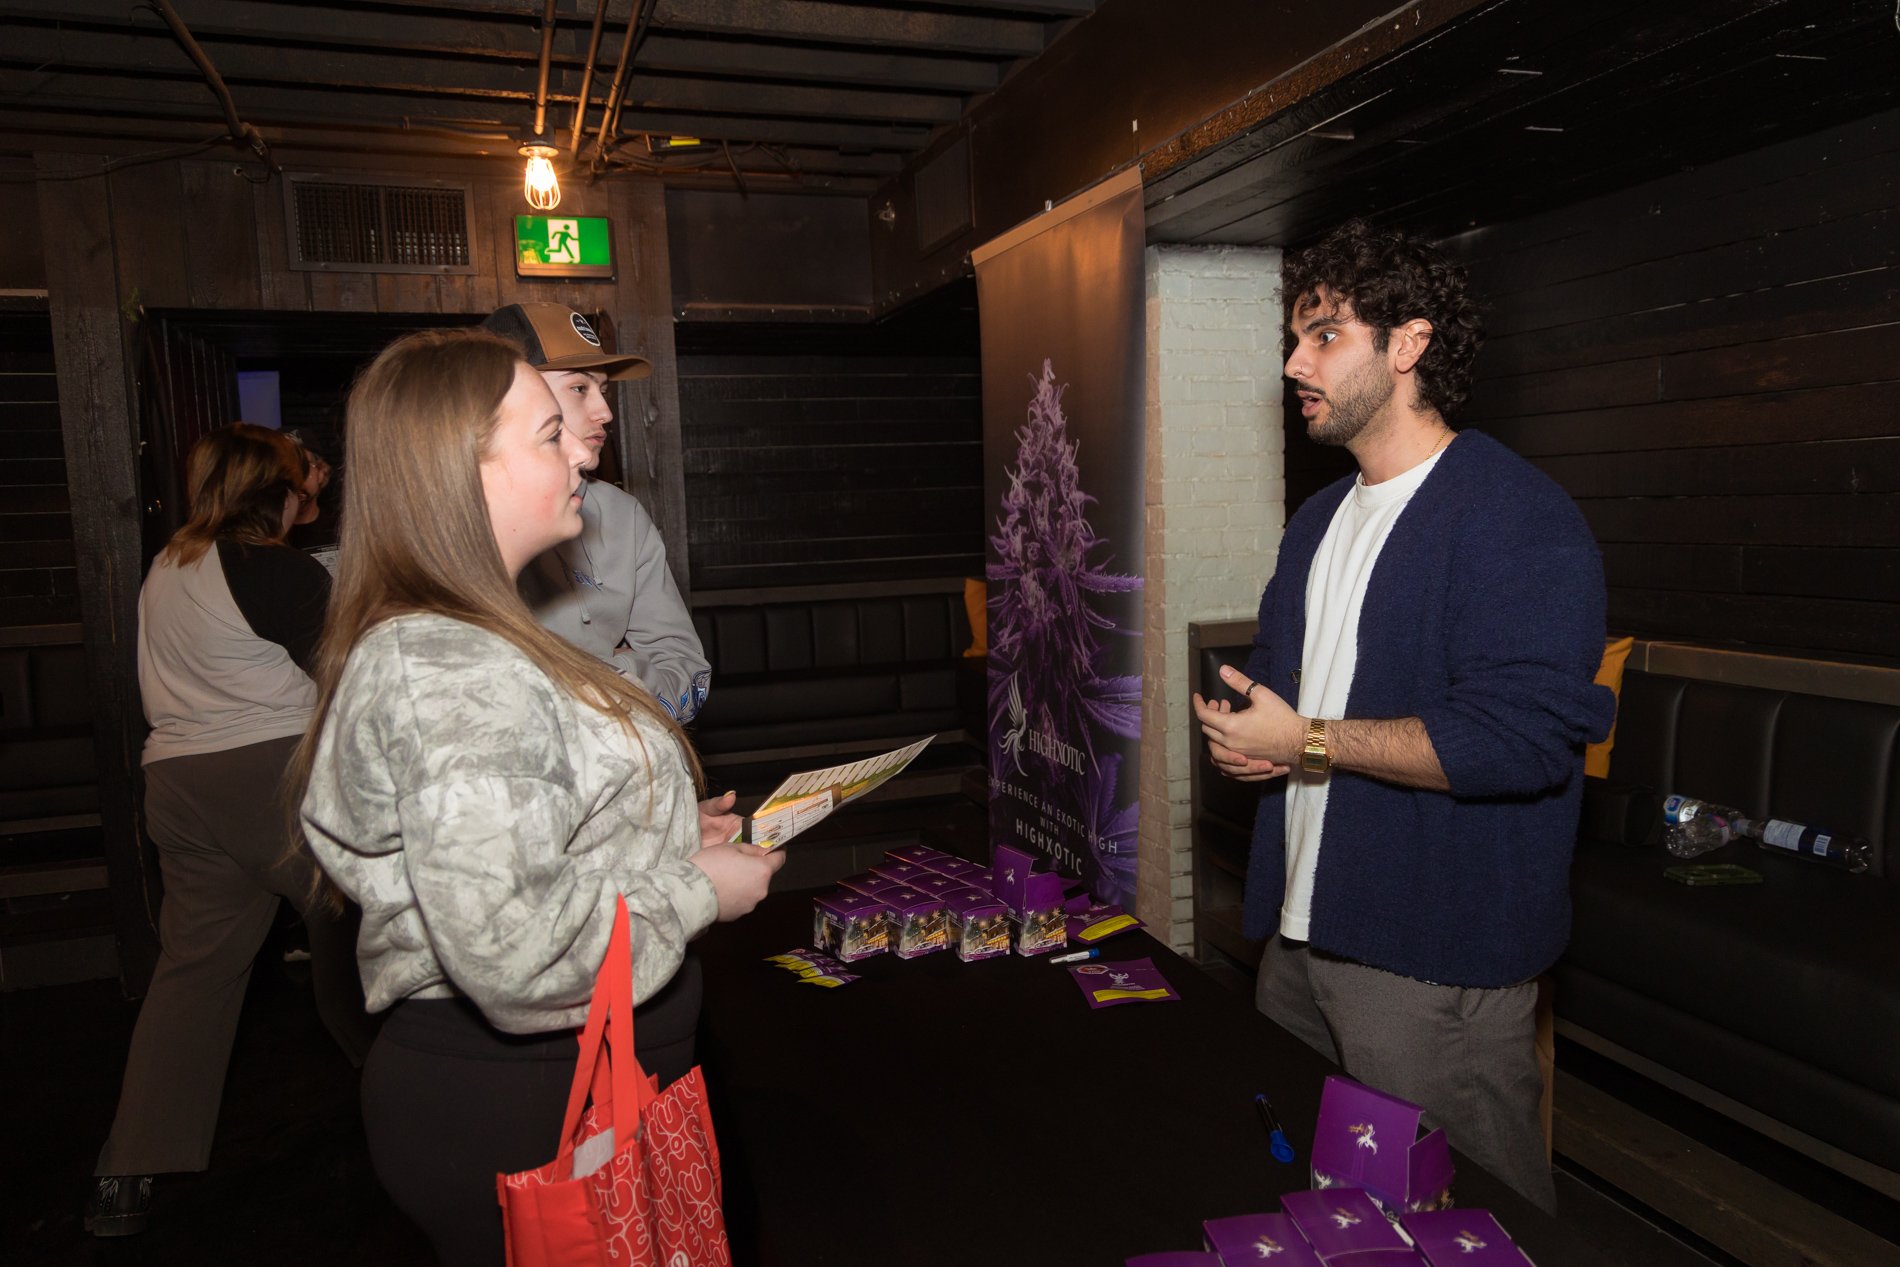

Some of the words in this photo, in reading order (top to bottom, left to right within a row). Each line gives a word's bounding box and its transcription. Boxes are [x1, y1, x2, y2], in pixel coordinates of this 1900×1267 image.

[1028, 728, 1086, 776] HIGHXOTIC
[1016, 818, 1082, 876] HIGHXOTIC
[1039, 816, 1059, 835] WITH
[1041, 801, 1053, 817] AN
[1056, 808, 1085, 838] EXOTIC
[1088, 829, 1118, 854] HIGH
